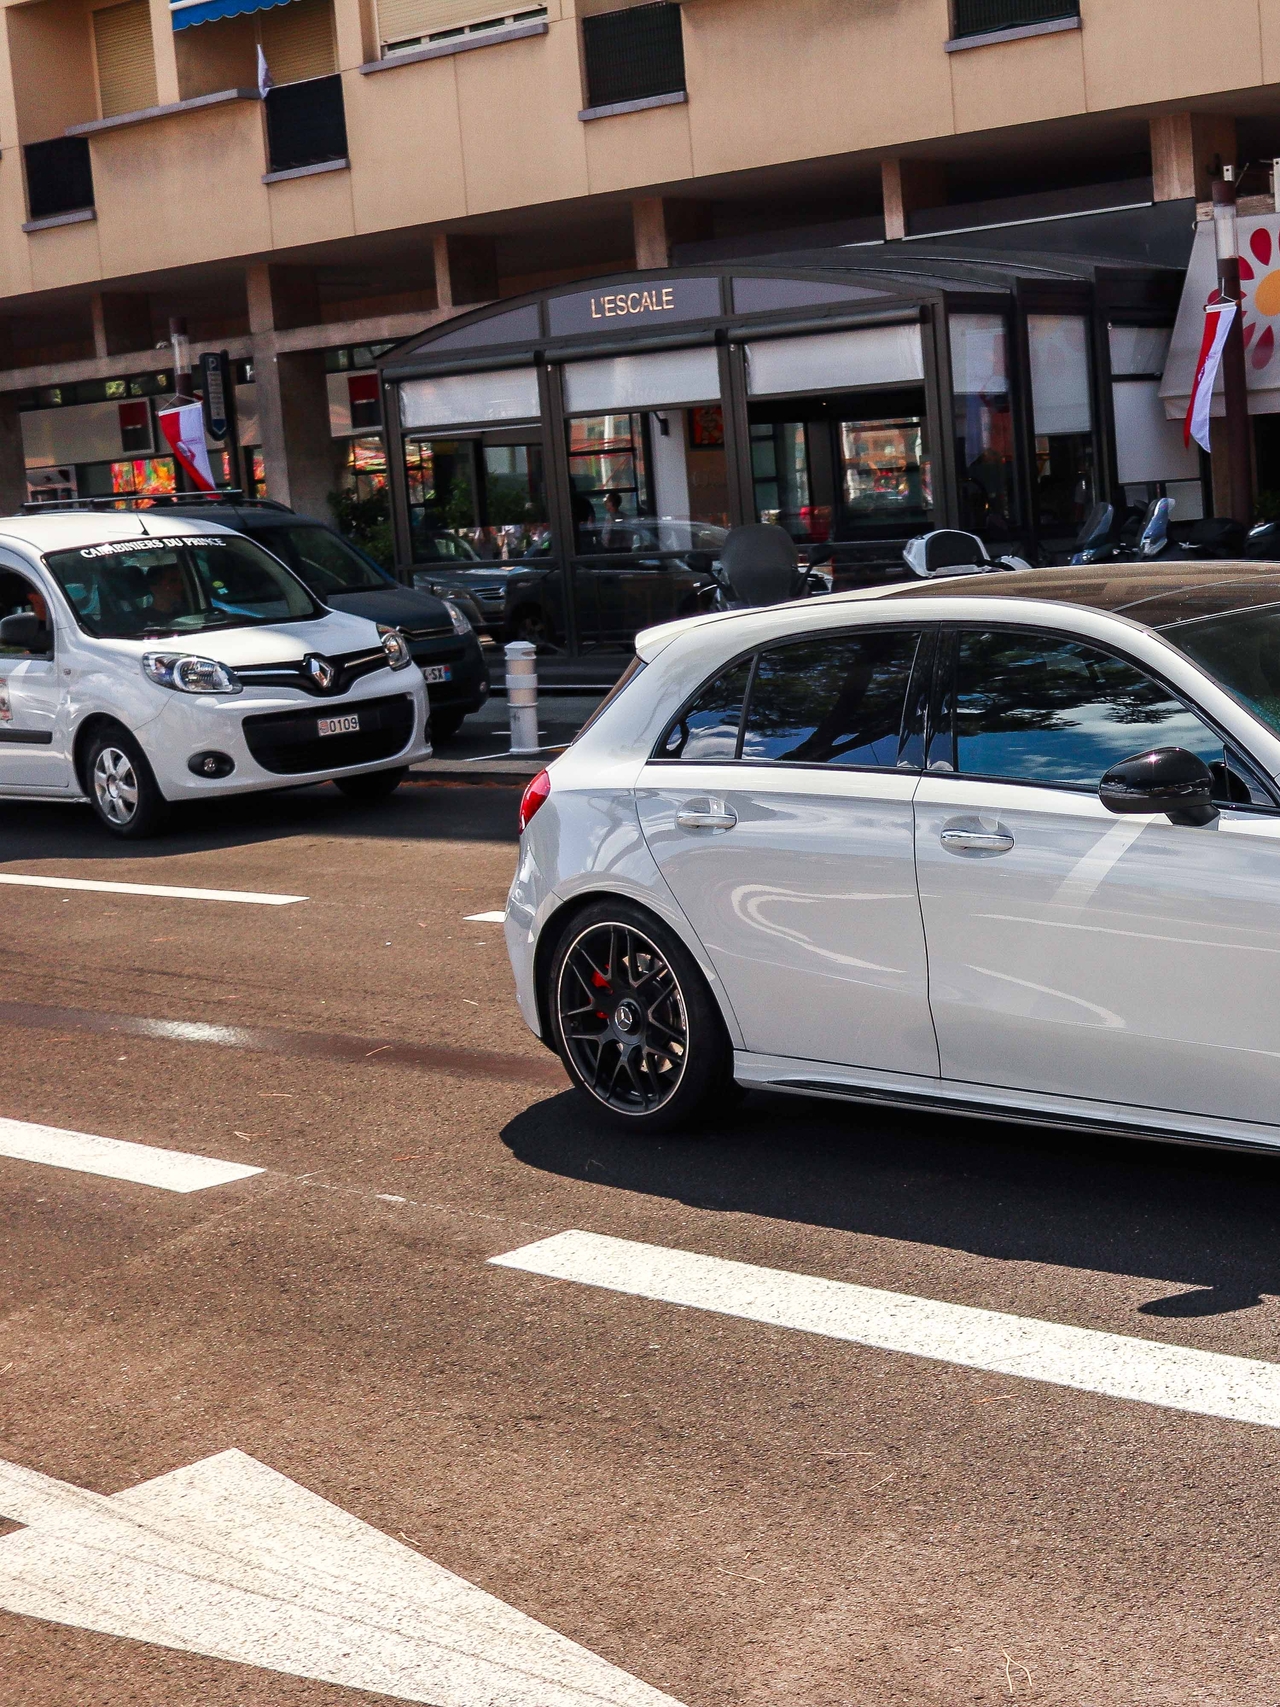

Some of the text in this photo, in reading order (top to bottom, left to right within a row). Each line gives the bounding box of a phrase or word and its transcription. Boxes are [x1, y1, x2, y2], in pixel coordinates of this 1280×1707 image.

[591, 287, 675, 318] L'ESCALE
[80, 537, 227, 558] CARABINIERS DU PRINCE
[329, 716, 358, 733] 0109
